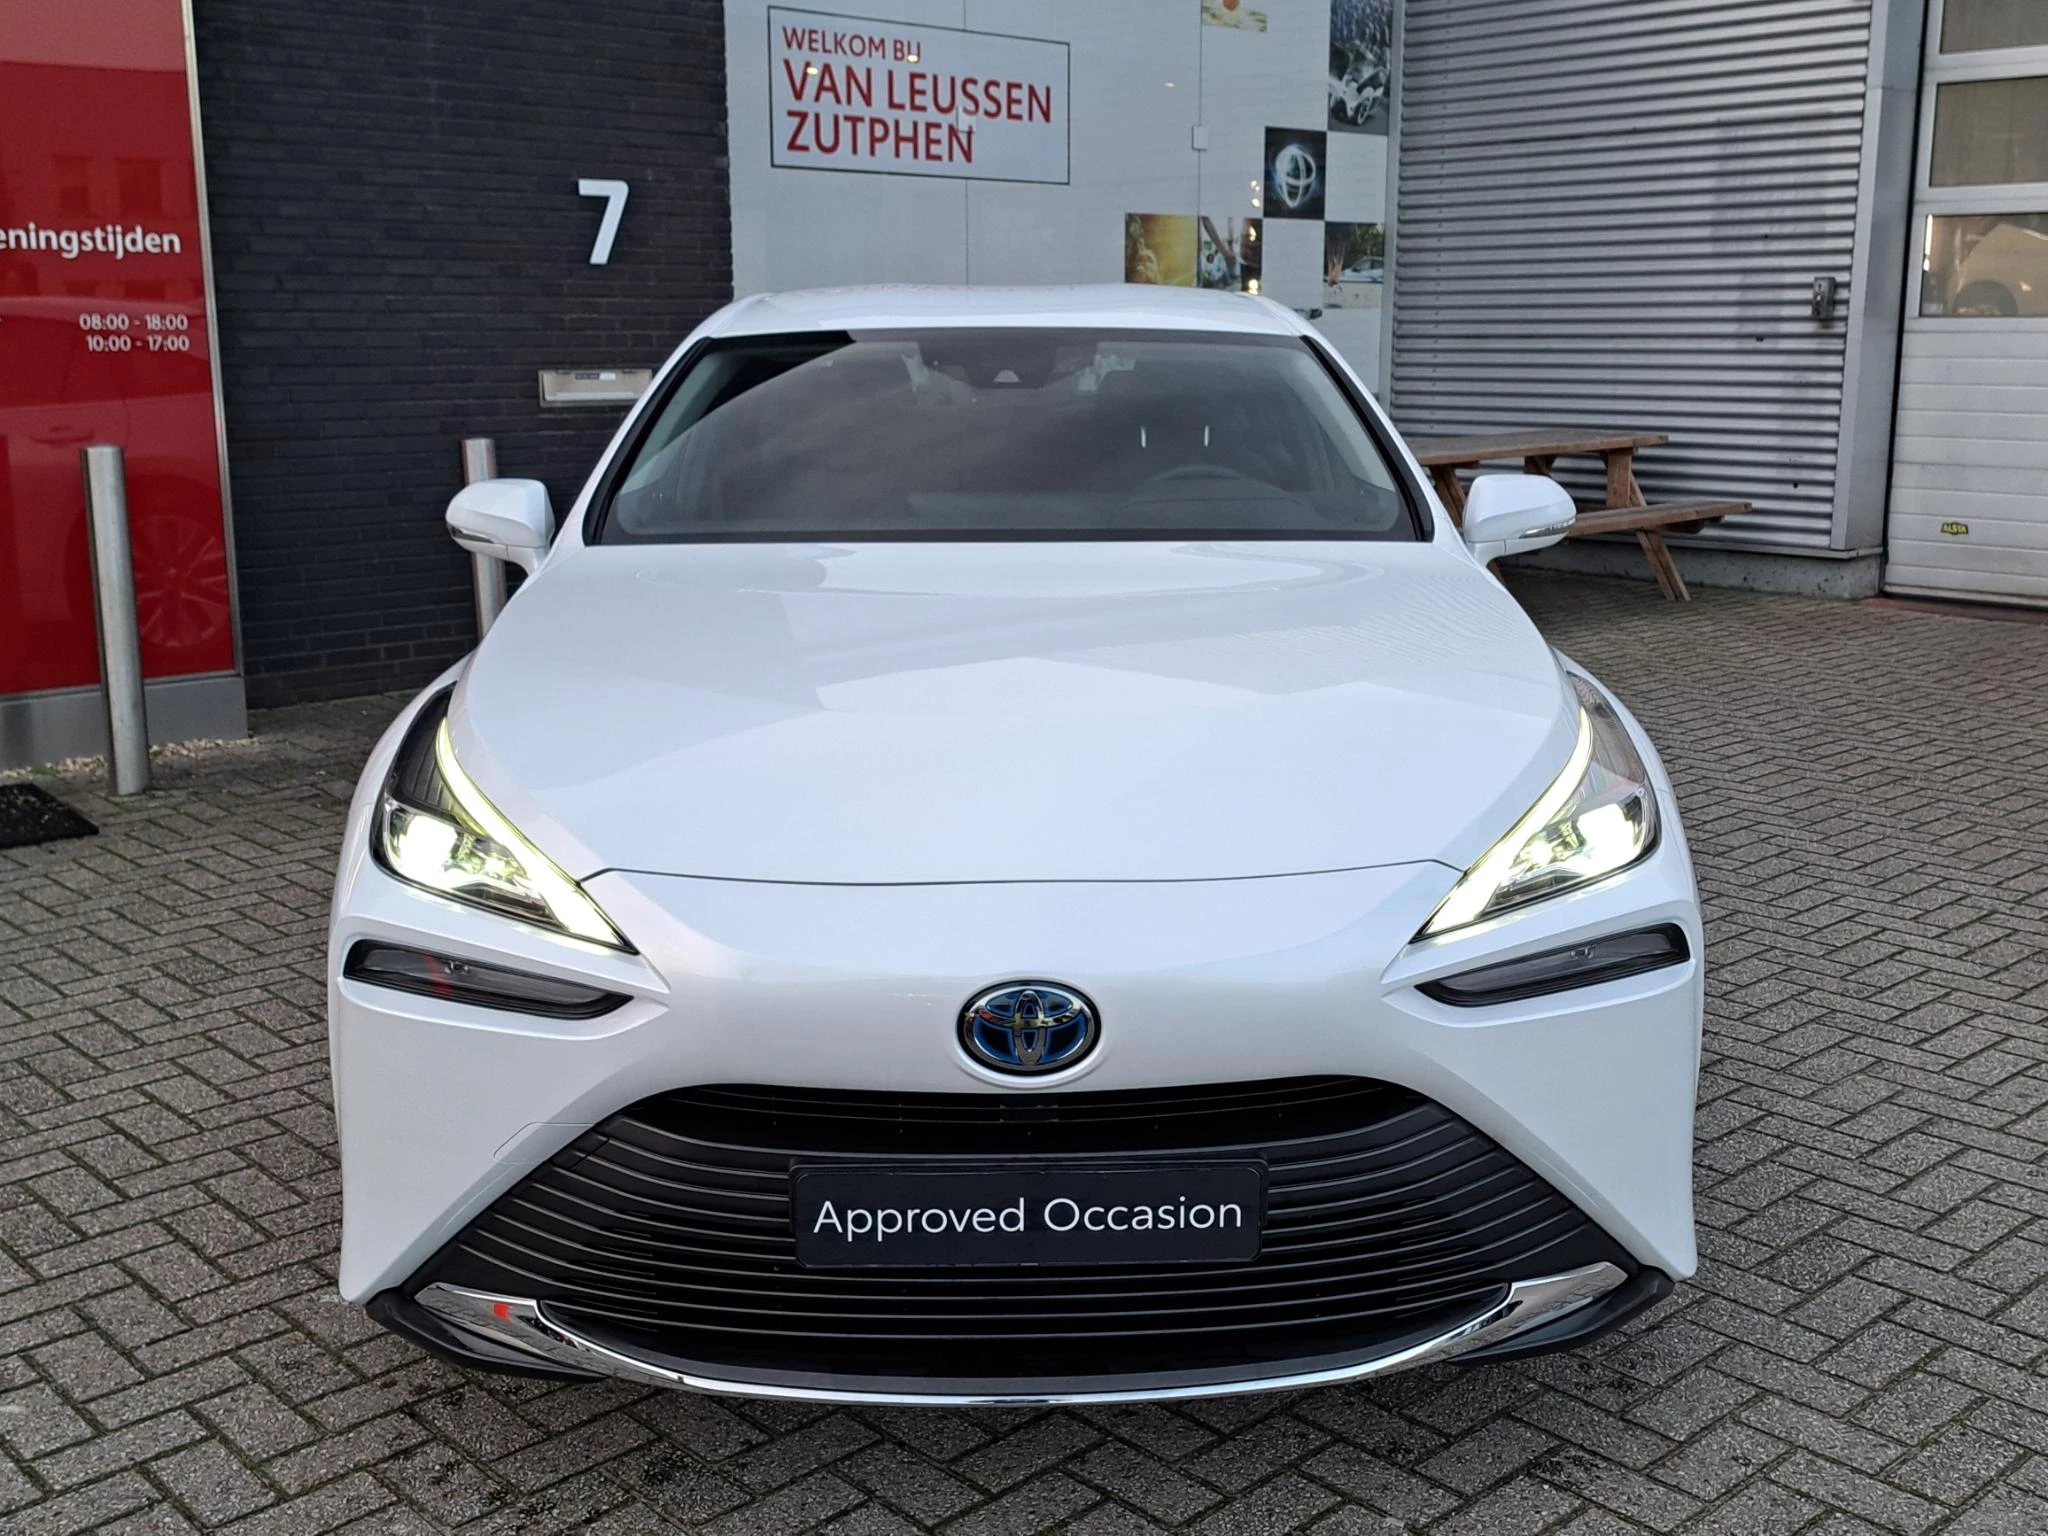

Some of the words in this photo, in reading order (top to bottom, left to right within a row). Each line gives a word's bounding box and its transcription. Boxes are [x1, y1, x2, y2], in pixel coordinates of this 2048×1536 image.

[782, 25, 886, 60] WELKOM
[783, 58, 872, 107] VAN
[887, 69, 1052, 124] LEUSSEN
[786, 110, 973, 163] ZUTPHEN
[578, 179, 630, 265] 7
[79, 313, 129, 330] 08:00
[145, 313, 188, 330] 18:00
[86, 335, 132, 352] 10:00
[147, 335, 190, 352] 17:00
[813, 1197, 1025, 1242] Approved
[1043, 1196, 1243, 1232] Occasion
